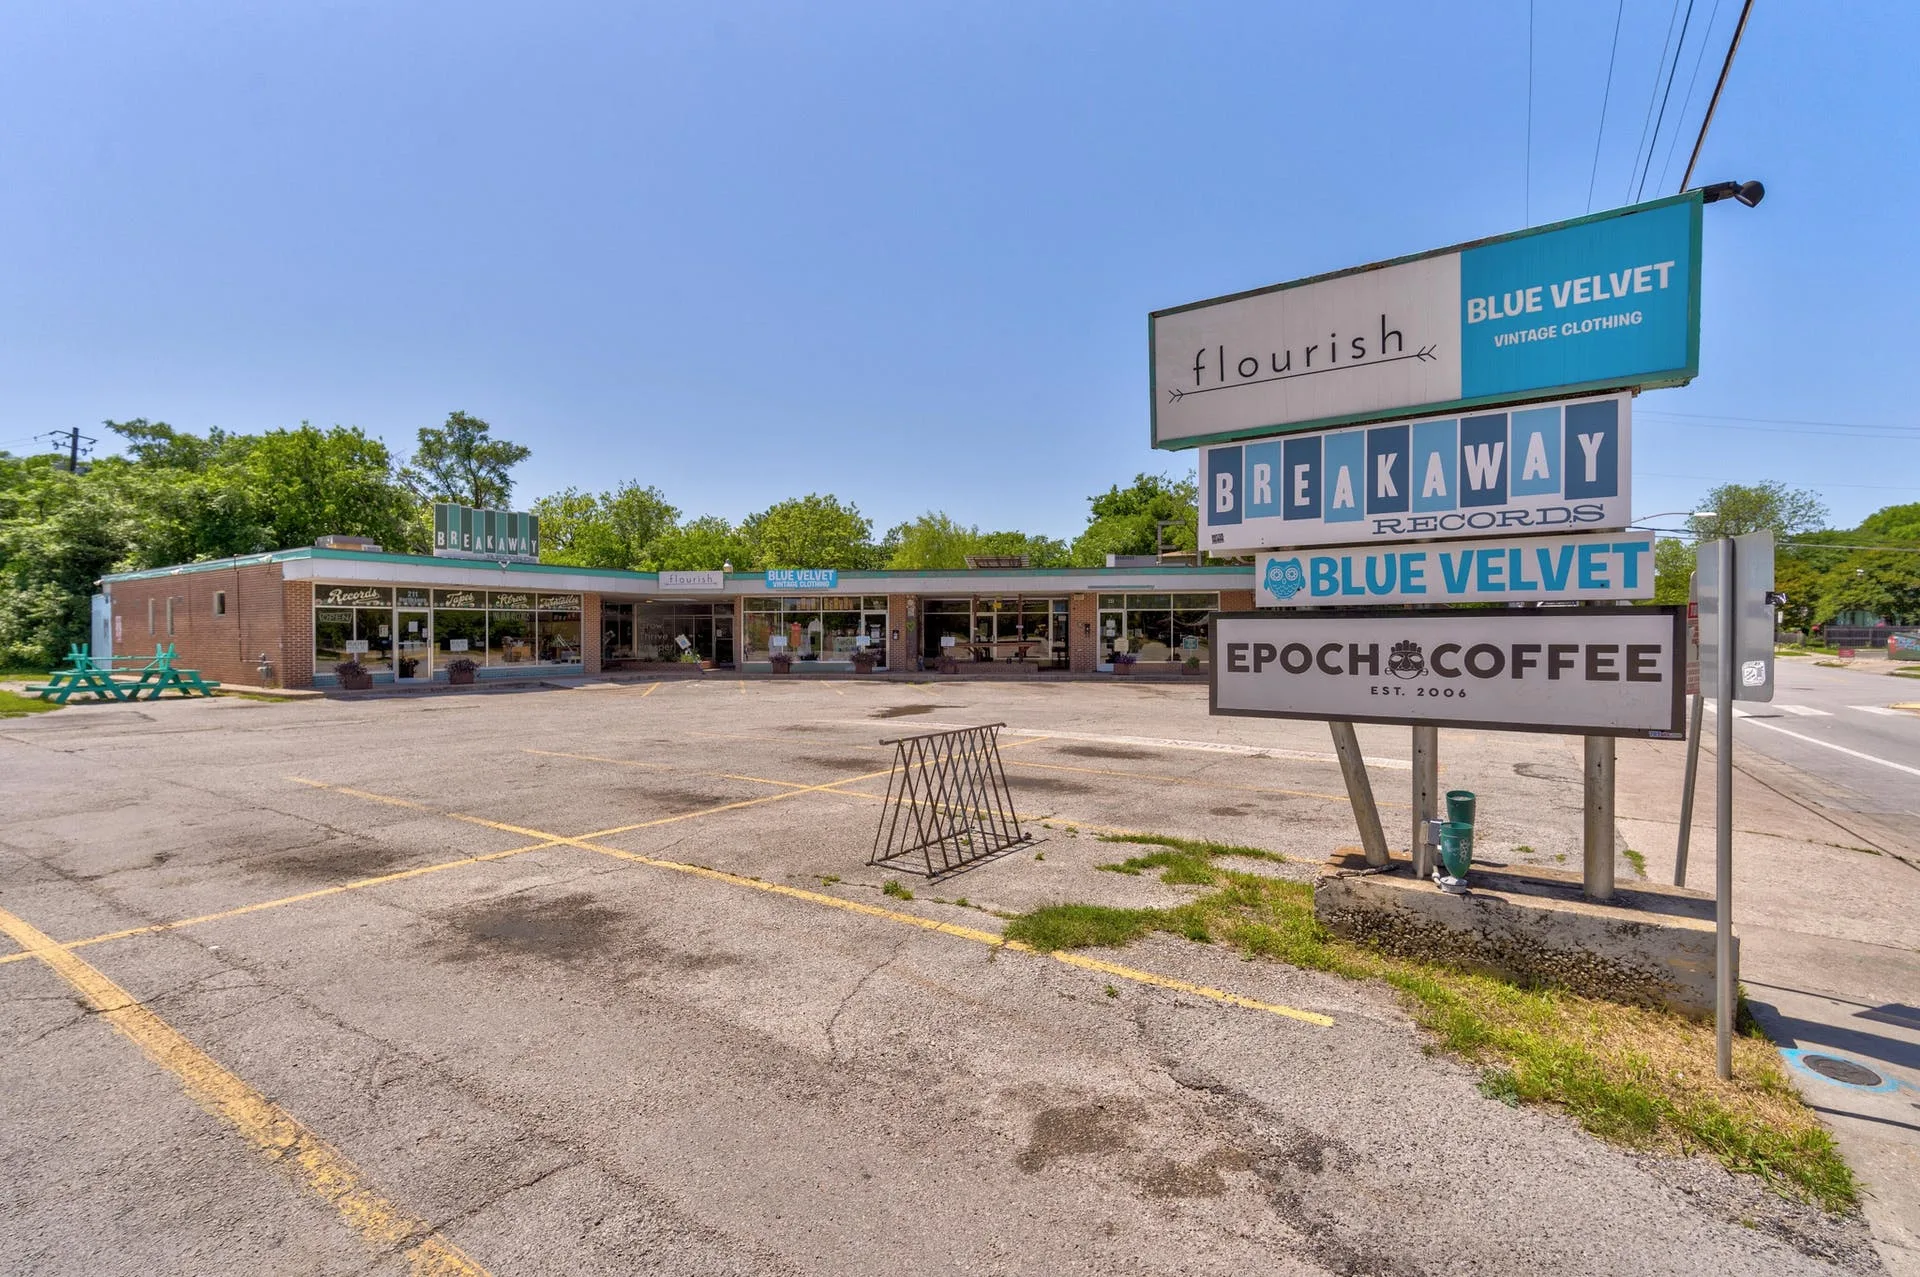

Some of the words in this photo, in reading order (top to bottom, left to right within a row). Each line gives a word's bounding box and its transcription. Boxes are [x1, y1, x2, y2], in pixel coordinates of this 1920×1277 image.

[1467, 287, 1543, 324] BLUE
[1549, 260, 1676, 309] VELVET
[1494, 324, 1557, 348] VINTAGE
[1561, 310, 1643, 337] CLOTHING
[1193, 313, 1403, 386] flourish
[1215, 431, 1605, 513] BREAKAWAY
[1372, 503, 1606, 535] RECORDS
[437, 530, 537, 554] BREAKAWAY
[668, 574, 714, 584] flourish
[768, 570, 795, 581] BLUE
[797, 569, 834, 581] VELVET
[1310, 552, 1426, 597] BLUE
[1439, 541, 1650, 595] VELVET
[328, 588, 381, 604] Records
[1226, 642, 1379, 676] EPOCH
[1430, 643, 1662, 682] COFFEE
[1370, 686, 1406, 697] EST.
[1416, 686, 1468, 698] 2006
